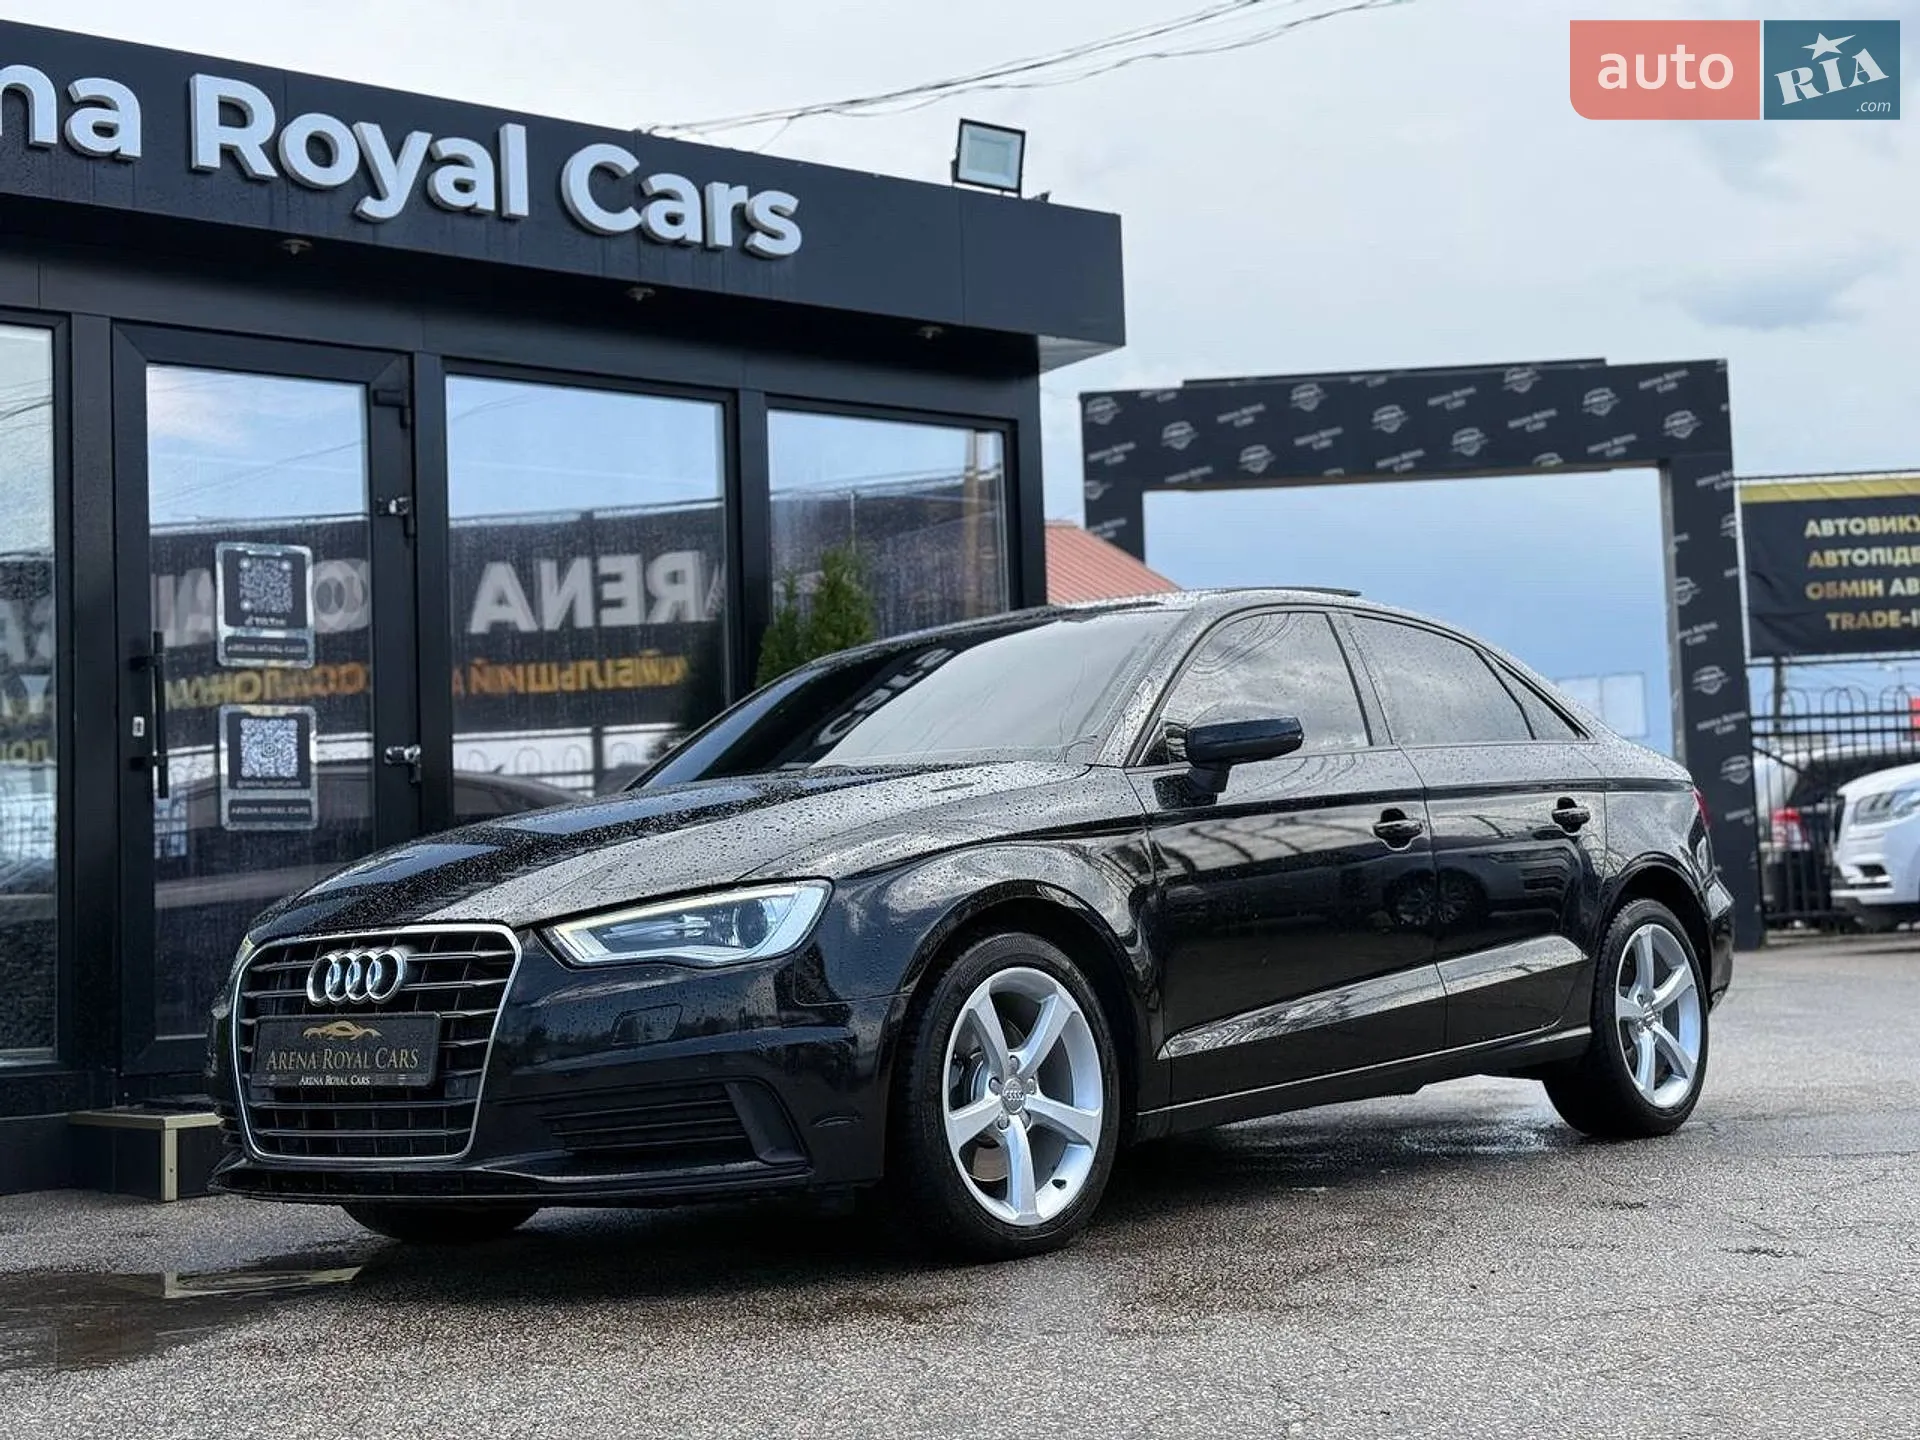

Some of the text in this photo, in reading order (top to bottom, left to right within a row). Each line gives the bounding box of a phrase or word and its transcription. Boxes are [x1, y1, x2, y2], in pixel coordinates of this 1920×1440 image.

[190, 73, 529, 222] Royal
[561, 142, 802, 260] Cars
[1805, 579, 1884, 600] ОБМІН
[1825, 608, 1920, 632] TRADE-I
[266, 1047, 419, 1071] ARENA ROYAL CARS
